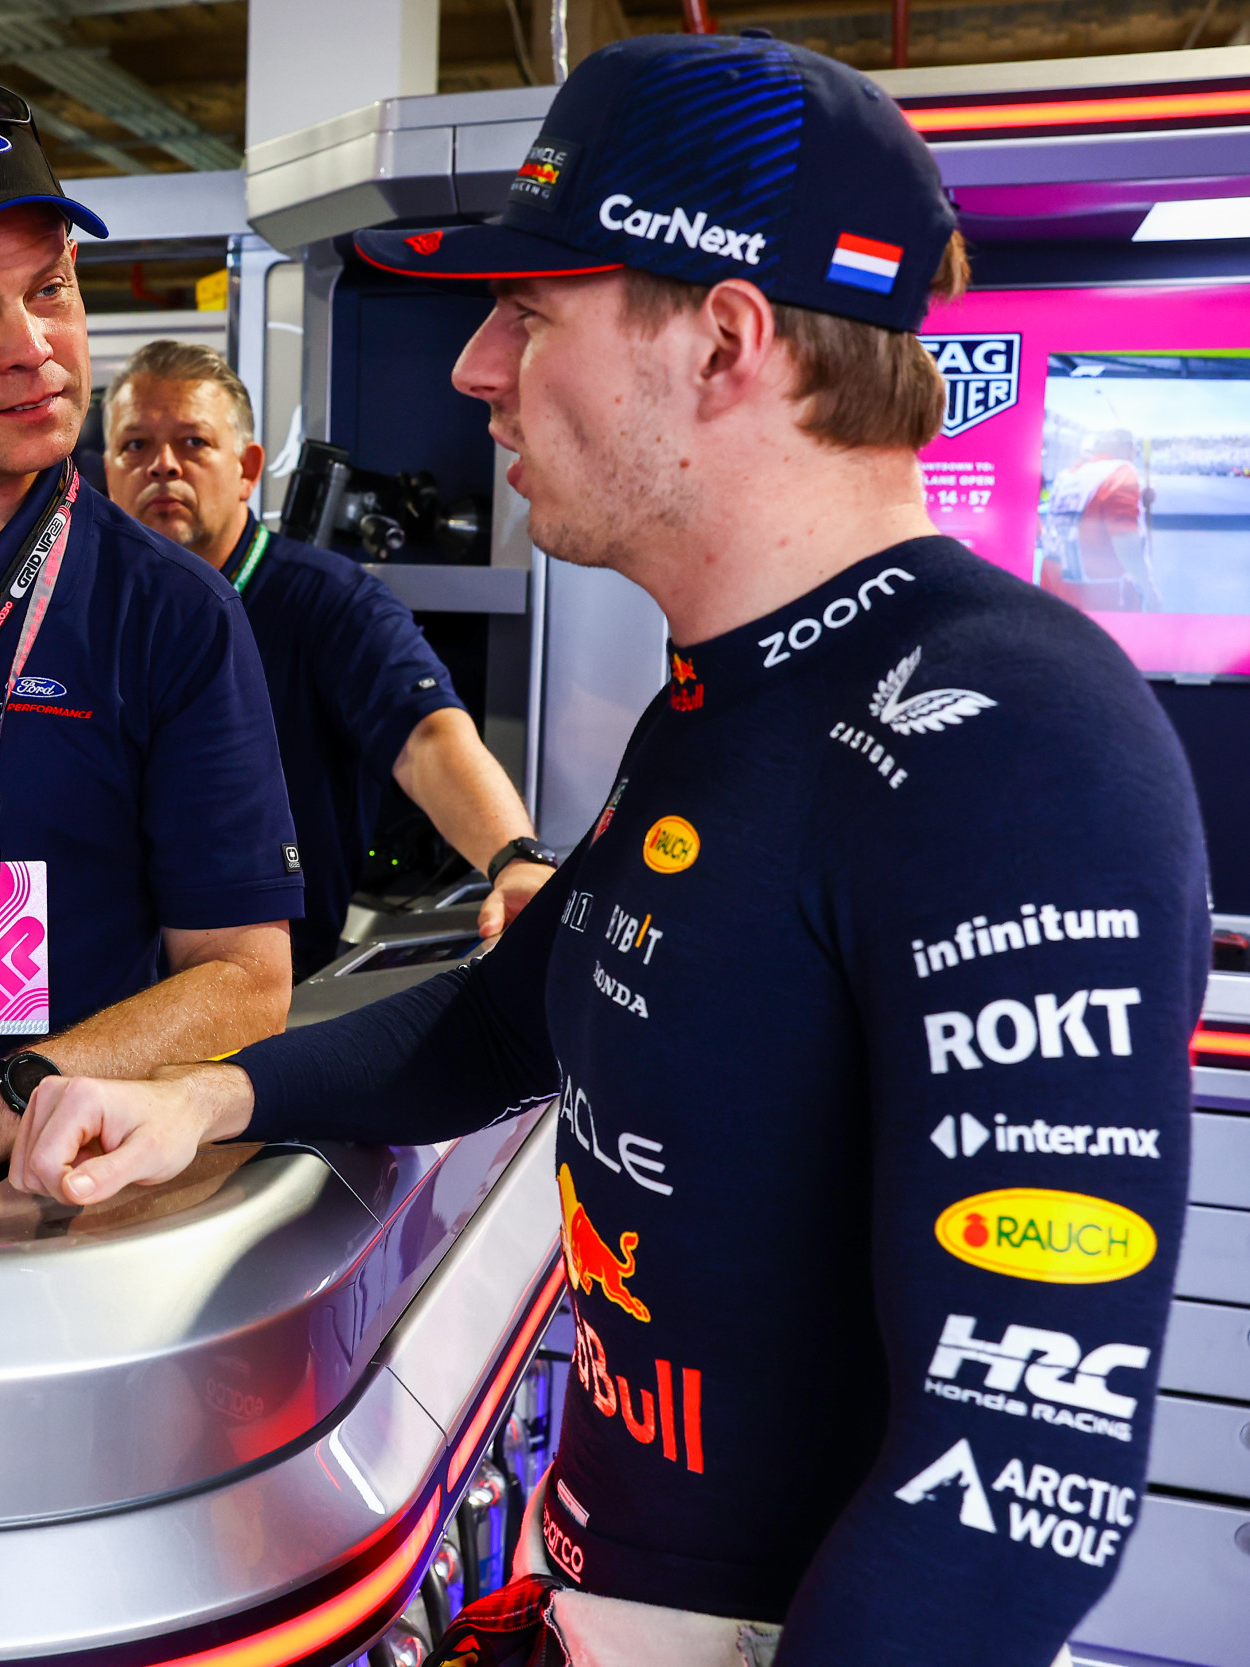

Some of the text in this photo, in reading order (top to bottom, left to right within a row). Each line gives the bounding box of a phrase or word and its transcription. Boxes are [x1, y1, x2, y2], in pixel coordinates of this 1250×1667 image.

[599, 194, 767, 265] CarNext
[943, 380, 1010, 428] UER
[17, 554, 42, 588] GRID
[758, 567, 916, 669] zoom
[7, 703, 93, 719] PERFORMANCE
[17, 679, 55, 695] Ford
[829, 721, 908, 790] CASTORE
[911, 903, 1140, 978] infinitum
[924, 987, 1142, 1075] ROKT
[560, 1074, 674, 1196] ACLE
[993, 1112, 1160, 1159] inter.mx
[996, 1215, 1129, 1258] RAUCH
[928, 1313, 1151, 1419] HRC
[924, 1378, 1133, 1442] Honda RACING
[991, 1458, 1136, 1527] ARCTIC
[1009, 1502, 1121, 1567] WOLF
